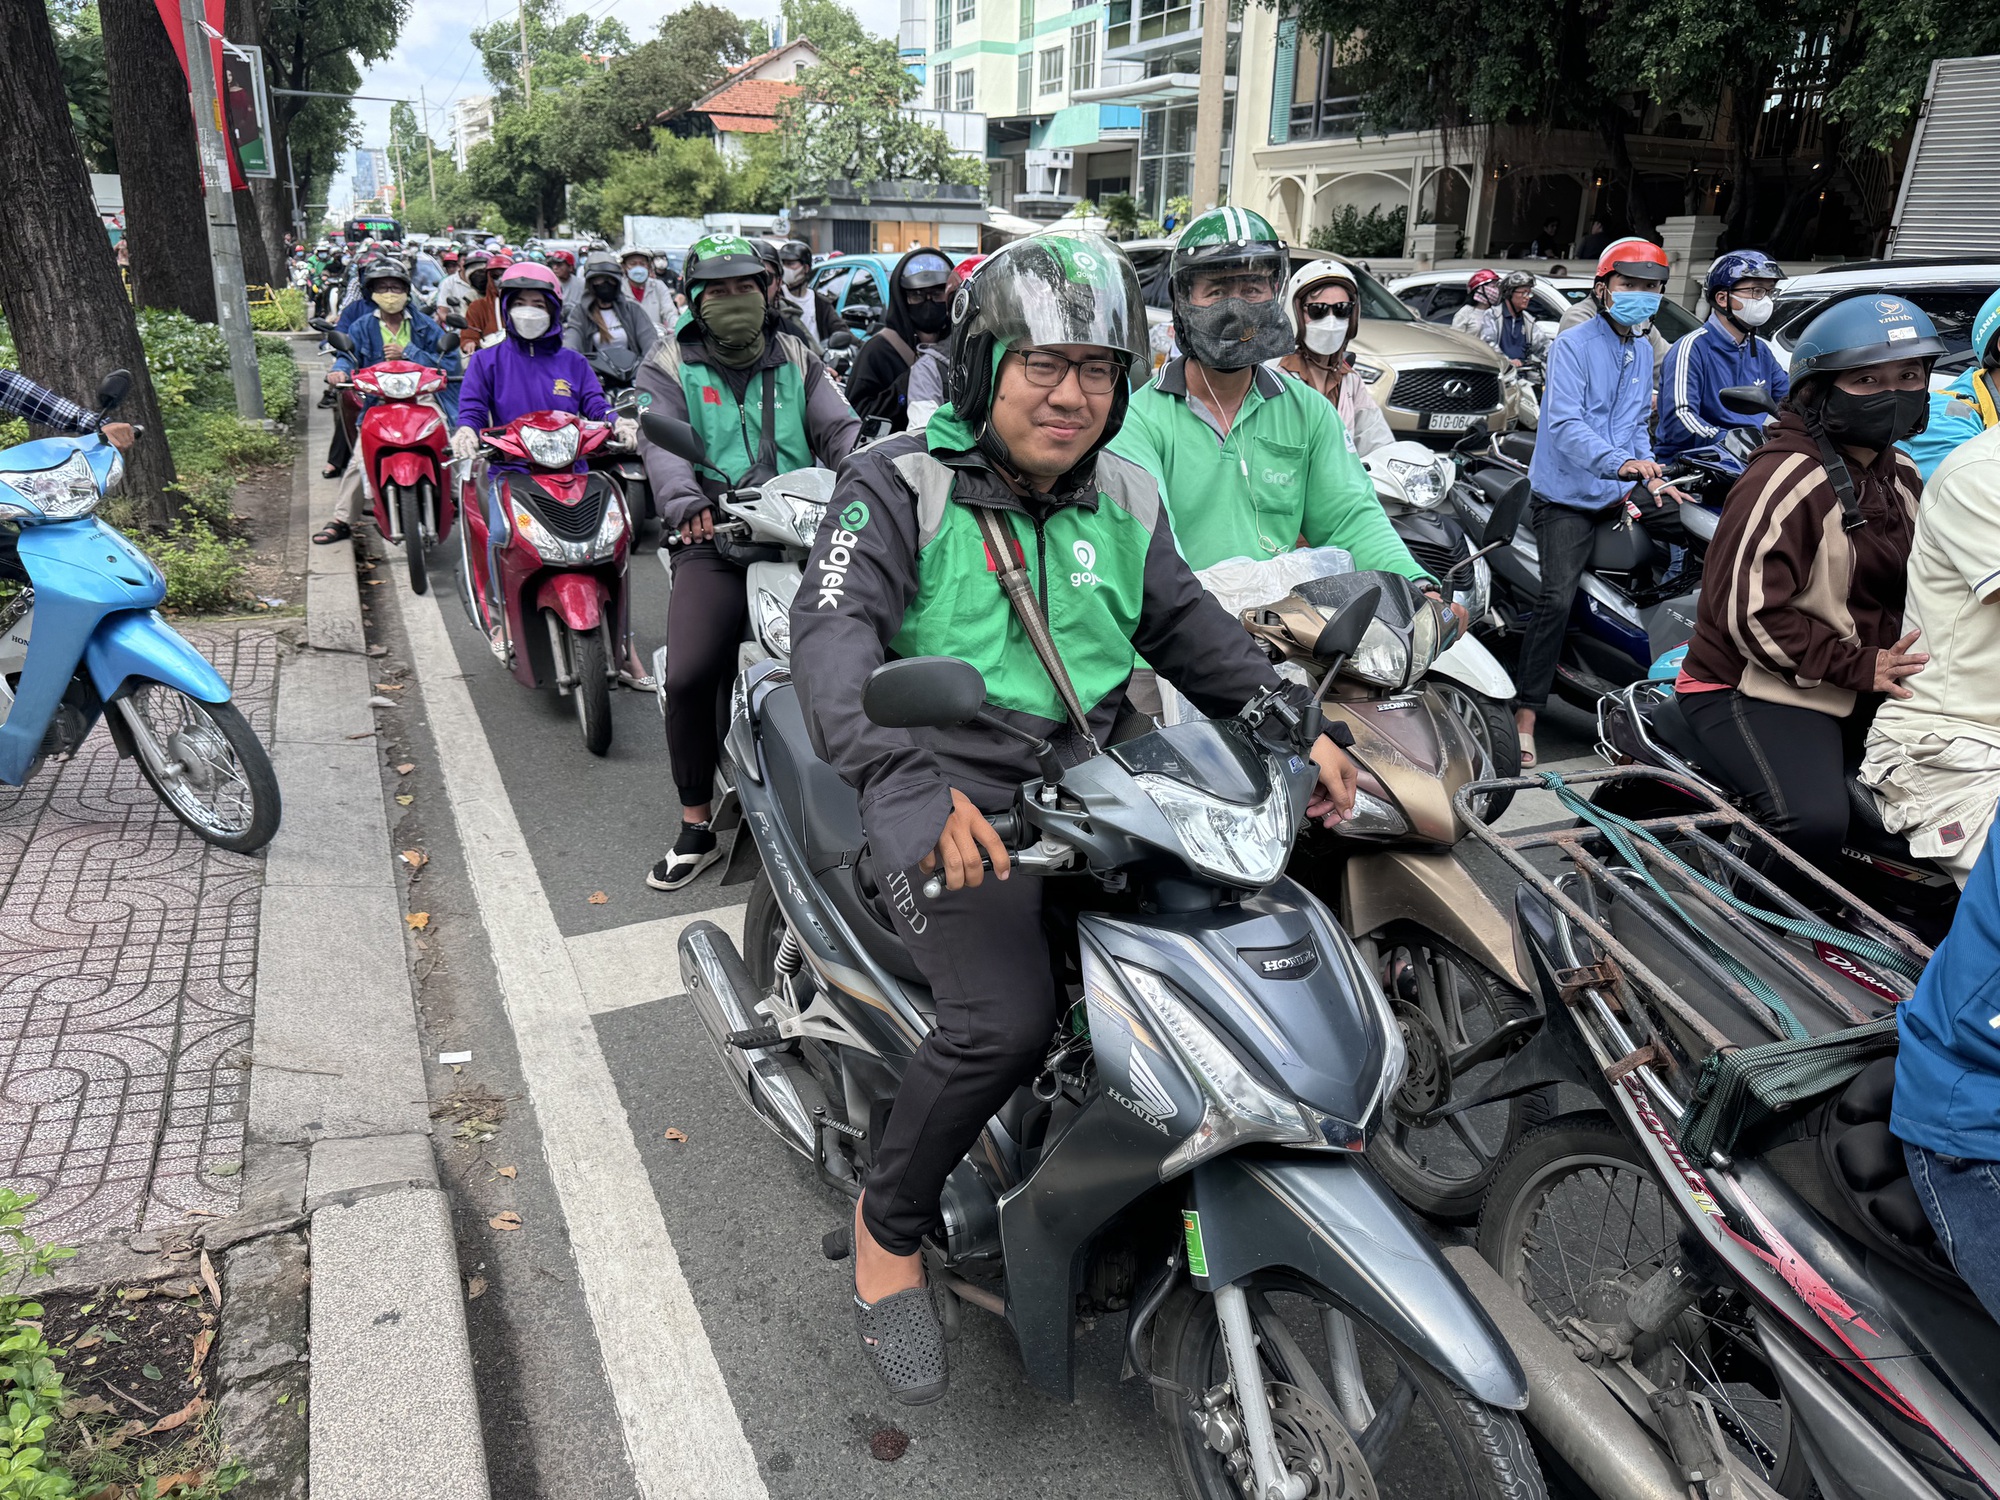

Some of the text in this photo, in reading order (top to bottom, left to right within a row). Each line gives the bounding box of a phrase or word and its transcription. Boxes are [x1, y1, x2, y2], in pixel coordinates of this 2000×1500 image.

[715, 244, 736, 253] gojek
[1076, 270, 1098, 281] gojek
[1975, 311, 1998, 344] XANH
[818, 528, 858, 609] gojek
[1070, 571, 1103, 587] goj
[11, 634, 30, 646] HON
[1841, 847, 1873, 864] NDA
[1825, 951, 1895, 993] Dream
[1107, 1086, 1170, 1136] HONDA
